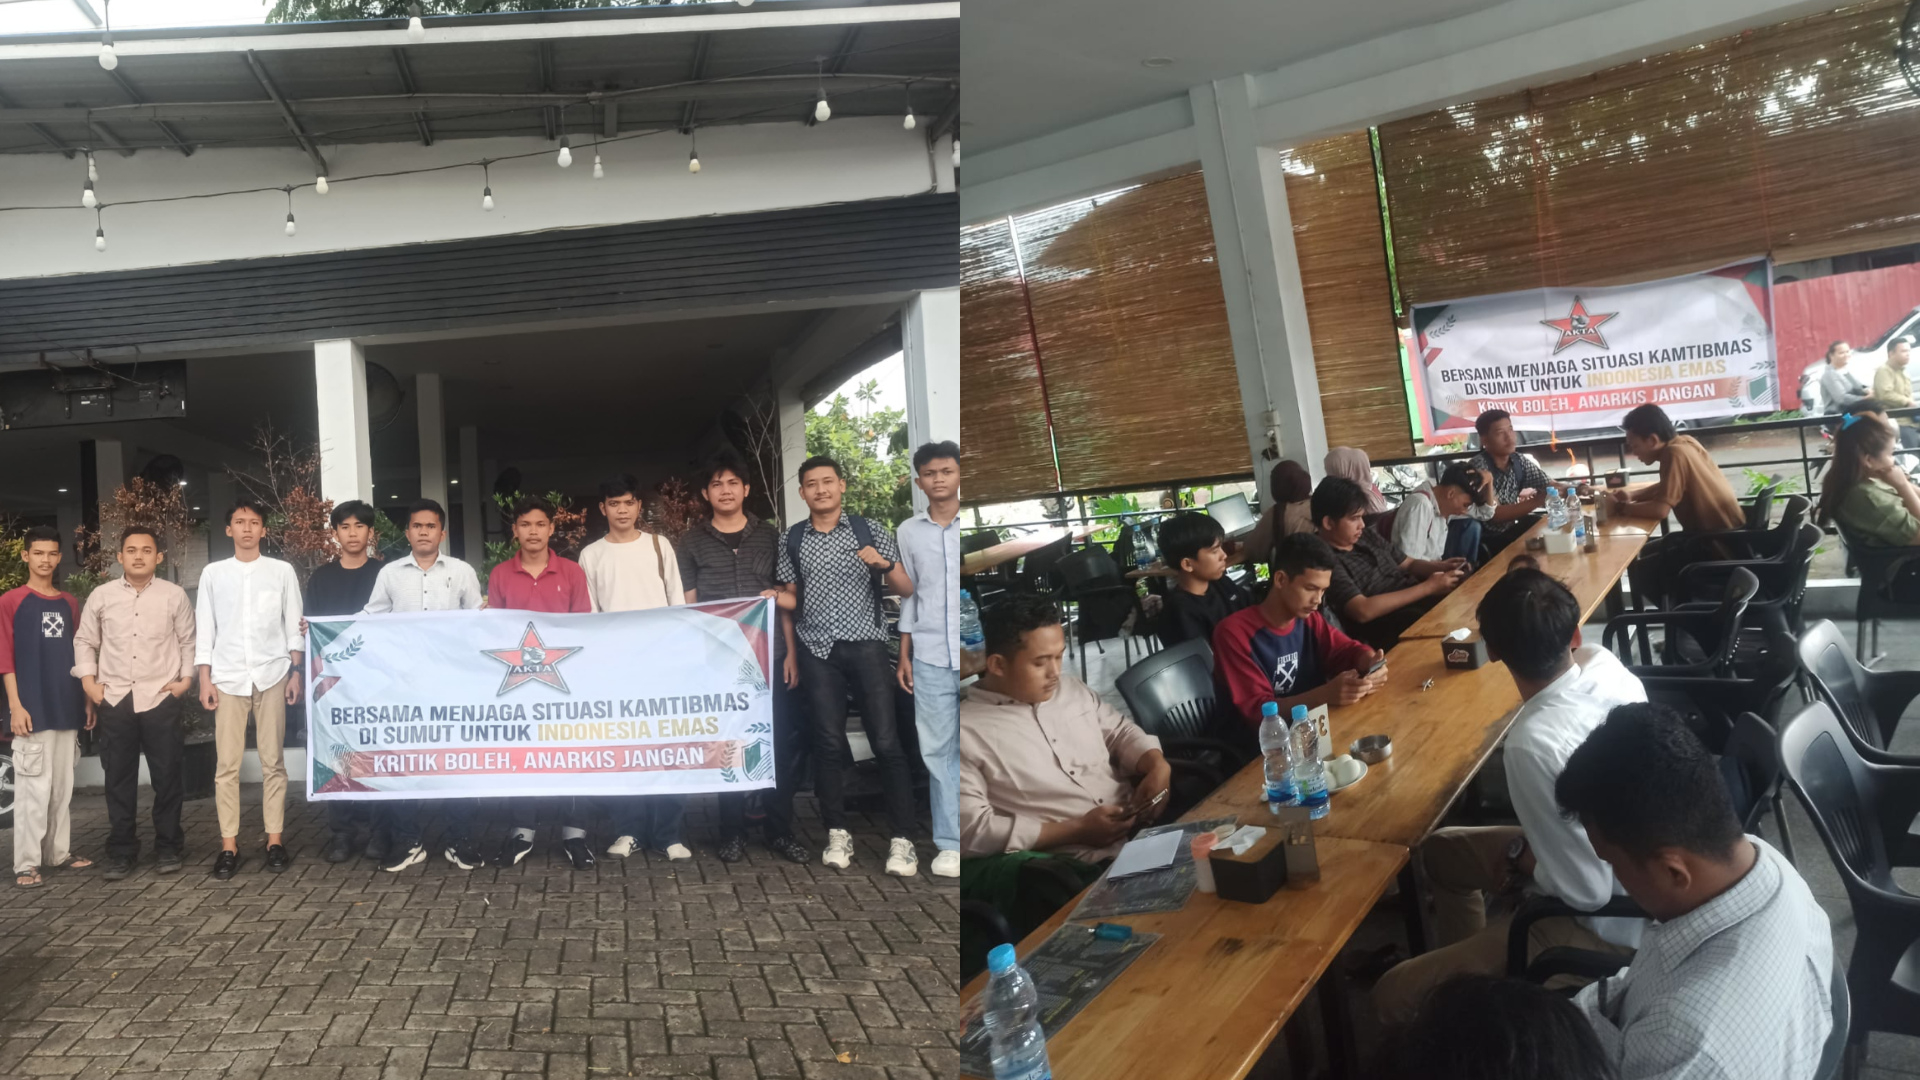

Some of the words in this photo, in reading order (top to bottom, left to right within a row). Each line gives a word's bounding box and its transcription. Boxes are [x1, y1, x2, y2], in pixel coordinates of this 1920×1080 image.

[1565, 328, 1595, 336] AKTA
[1441, 366, 1503, 383] BERSAMA
[1507, 359, 1578, 378] MENJAGA
[1581, 352, 1644, 371] SITUASI
[1649, 338, 1752, 364] KAMTIBMAS
[1464, 382, 1478, 395] DI
[1479, 380, 1526, 395] SUMUT
[1531, 375, 1582, 391] UNTUK
[1586, 365, 1673, 387] INDONESIA
[1679, 359, 1726, 378] EMAS
[1523, 397, 1574, 413] BOLEH,
[1578, 390, 1647, 409] ANARKIS
[1651, 383, 1716, 403] JANGAN
[513, 665, 552, 673] AKTA
[331, 705, 423, 725] BERSAMA
[430, 704, 527, 722] MENJAGA
[532, 700, 613, 721] SITUASI
[620, 692, 750, 718] KAMTIBMAS
[359, 727, 377, 745] DI
[383, 725, 455, 744] SUMUT
[461, 724, 531, 742] UNTUK
[538, 720, 652, 741] INDONESIA
[658, 716, 719, 738] EMAS
[374, 753, 438, 773] KRITIK
[445, 752, 517, 772] BOLEH,
[523, 750, 616, 769] ANARKIS
[622, 747, 704, 768] JANGAN
